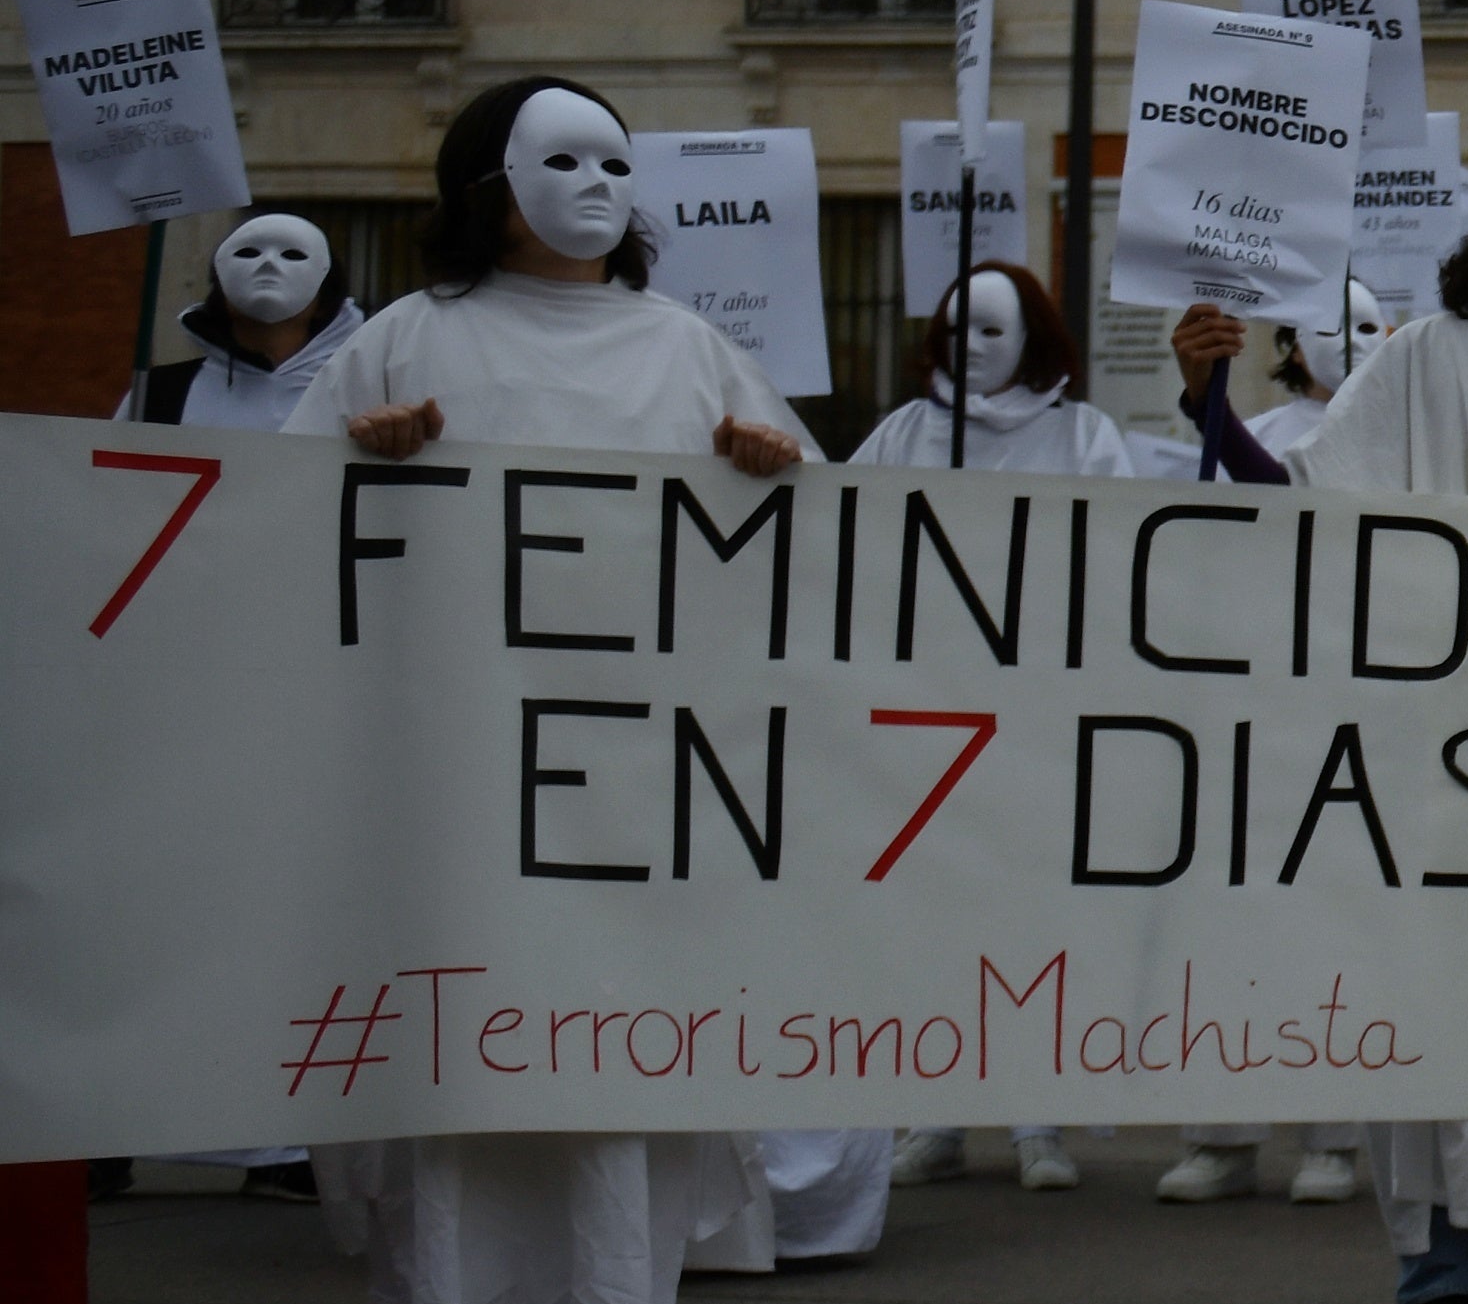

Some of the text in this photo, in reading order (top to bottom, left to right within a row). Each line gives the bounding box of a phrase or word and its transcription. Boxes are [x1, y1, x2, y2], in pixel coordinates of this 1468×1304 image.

[1215, 21, 1285, 39] ASESINADA
[44, 29, 206, 78] MADELEINE
[76, 60, 180, 97] VILUTA
[95, 97, 174, 125] 20 años
[1188, 82, 1308, 119] NOMBRE
[1140, 101, 1349, 150] DESCONOCIDO
[675, 199, 772, 228] LAILA
[909, 191, 1018, 215] SANRA
[1191, 189, 1285, 224] 16 dias
[1194, 224, 1274, 251] MALAGA
[1186, 241, 1279, 272] (MALAGA)
[722, 291, 769, 312] años
[89, 449, 223, 640] 7
[520, 699, 787, 883] EN
[863, 709, 998, 883] 7
